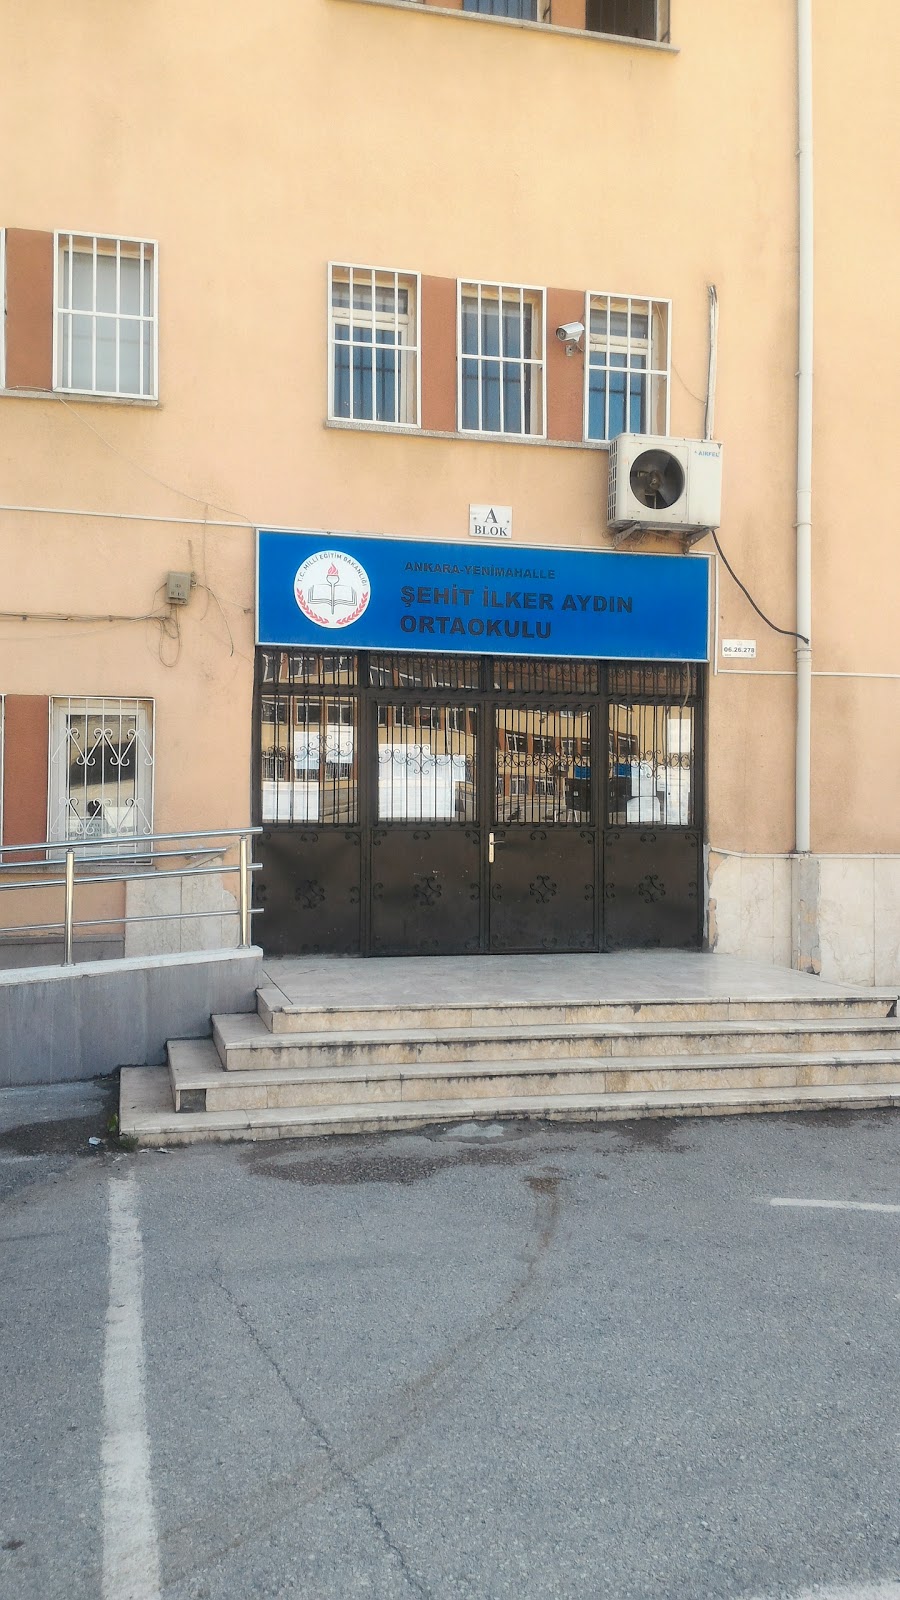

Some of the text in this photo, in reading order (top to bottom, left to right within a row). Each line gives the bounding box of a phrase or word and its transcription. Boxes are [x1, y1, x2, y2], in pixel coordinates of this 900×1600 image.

[484, 507, 498, 524] A
[474, 524, 508, 537] BLOK
[303, 555, 319, 570] MİLLİ
[319, 551, 342, 560] EĞİTİM
[404, 561, 556, 580] ANKARA-YENİMAHALLE
[400, 583, 633, 614] ŞEHİT İLKER AYDIN
[400, 614, 552, 639] ORTAOKULU
